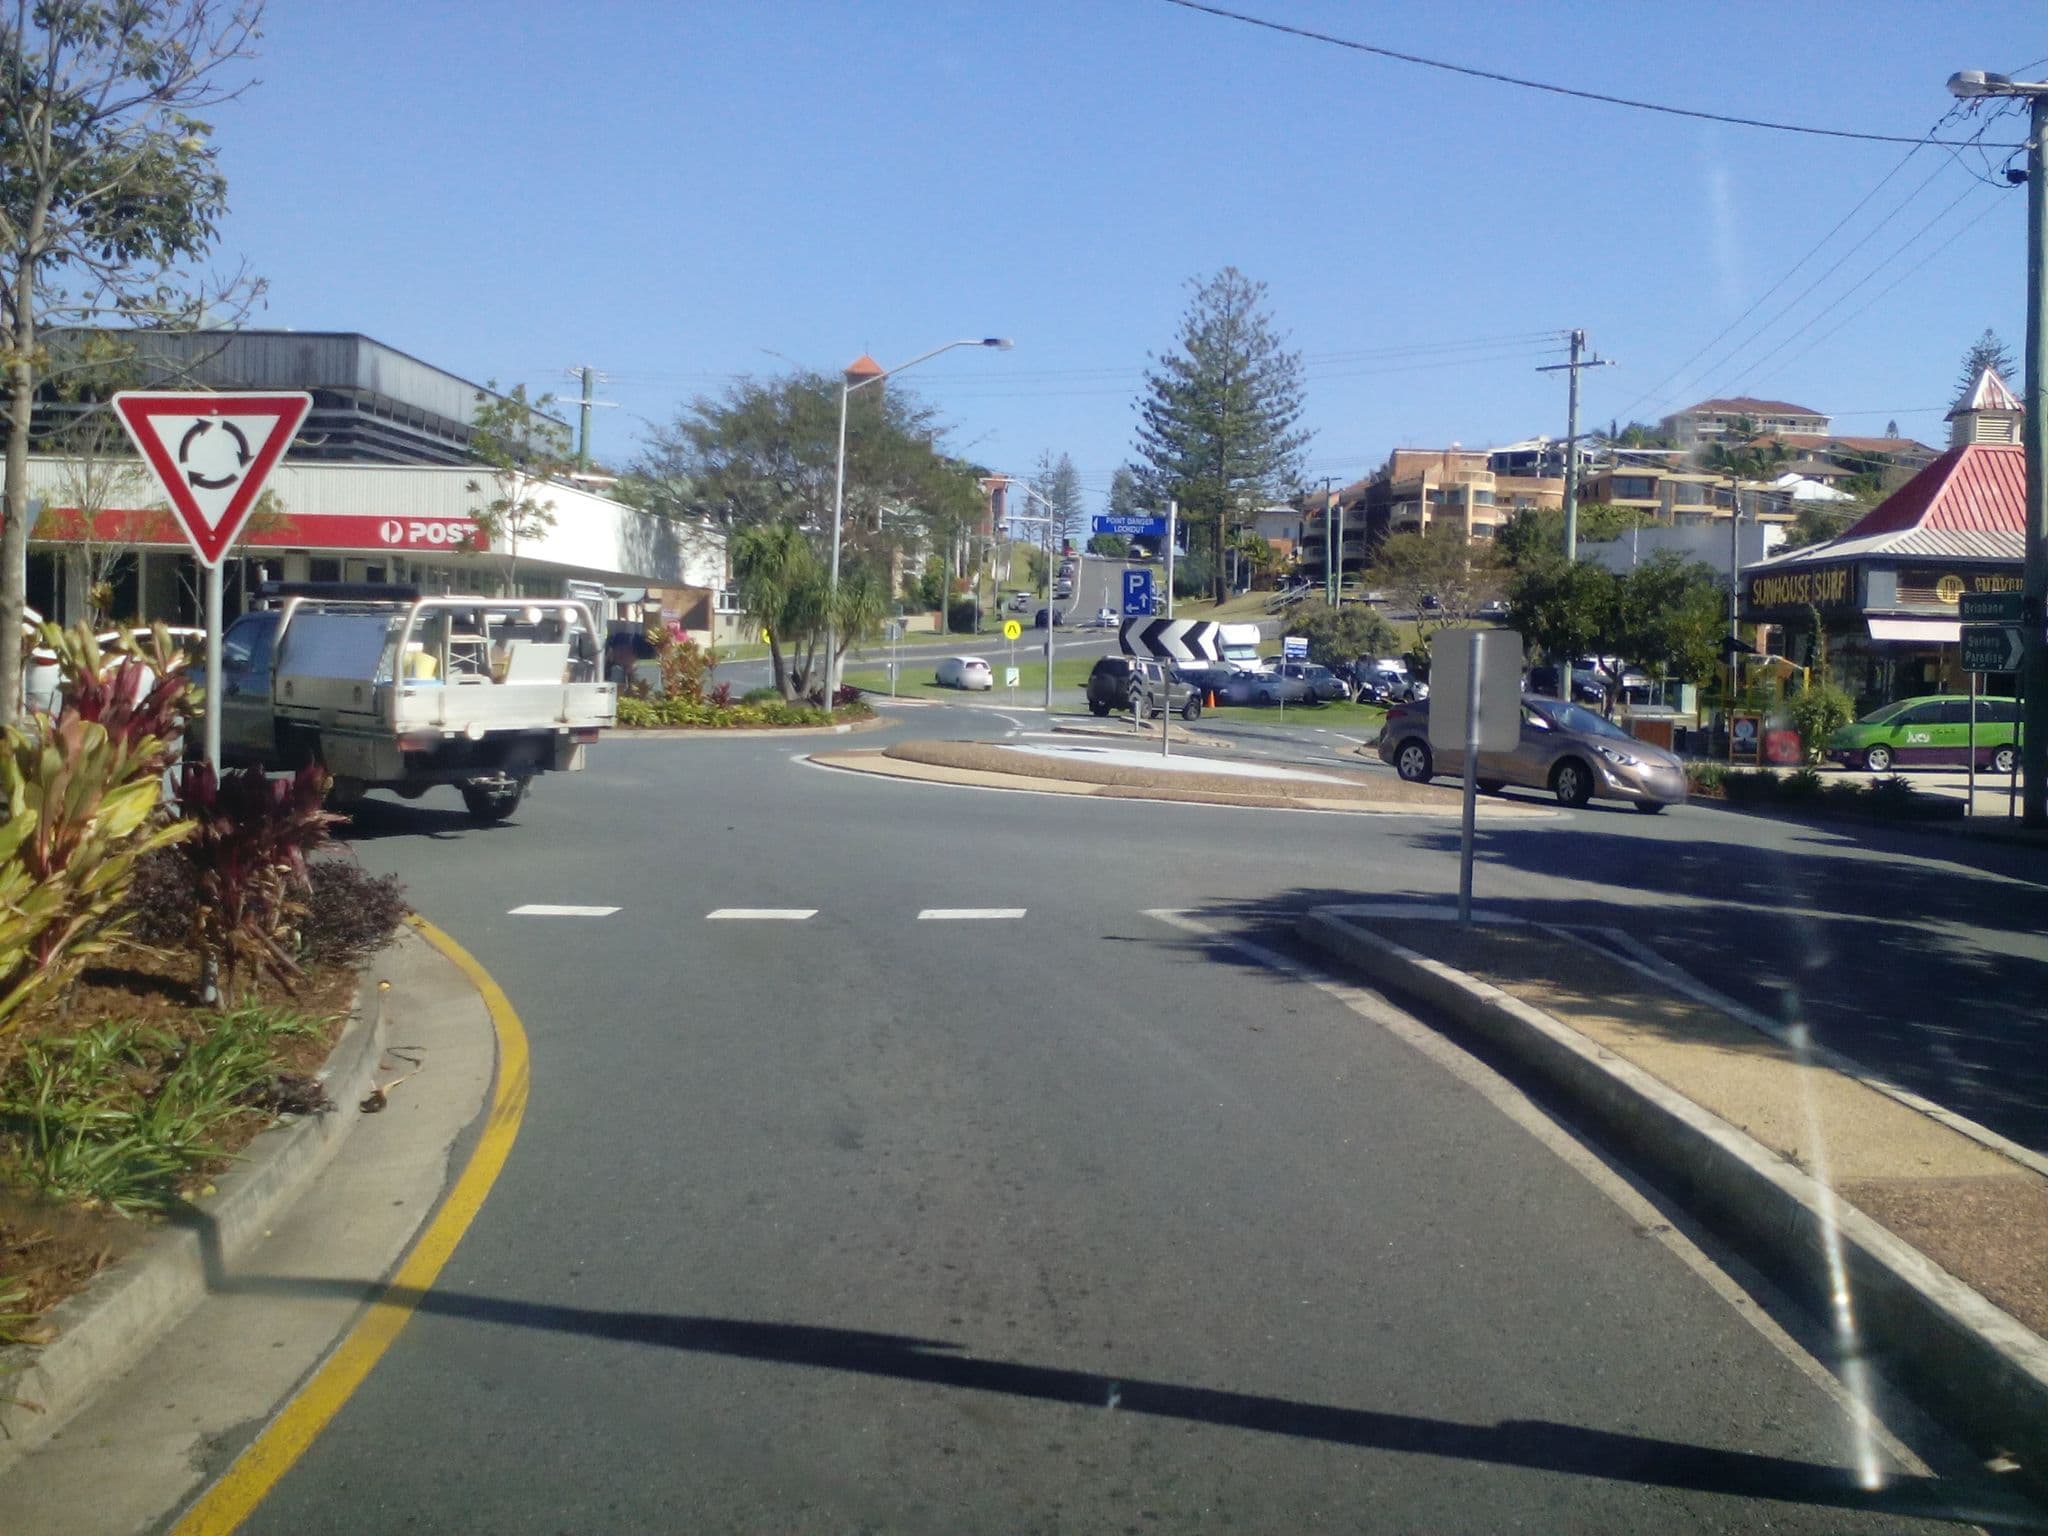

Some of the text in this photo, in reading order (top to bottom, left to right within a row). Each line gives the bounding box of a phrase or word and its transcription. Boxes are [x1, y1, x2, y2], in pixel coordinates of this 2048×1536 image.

[1106, 517, 1154, 526] POINT DANGER
[409, 522, 480, 544] POST
[1113, 525, 1145, 533] LOOKOUT
[1129, 575, 1144, 594] P
[1753, 570, 1847, 606] SUNHOUSE SURF
[1964, 602, 2004, 614] Brisbane
[1965, 651, 2004, 664] Paradise
